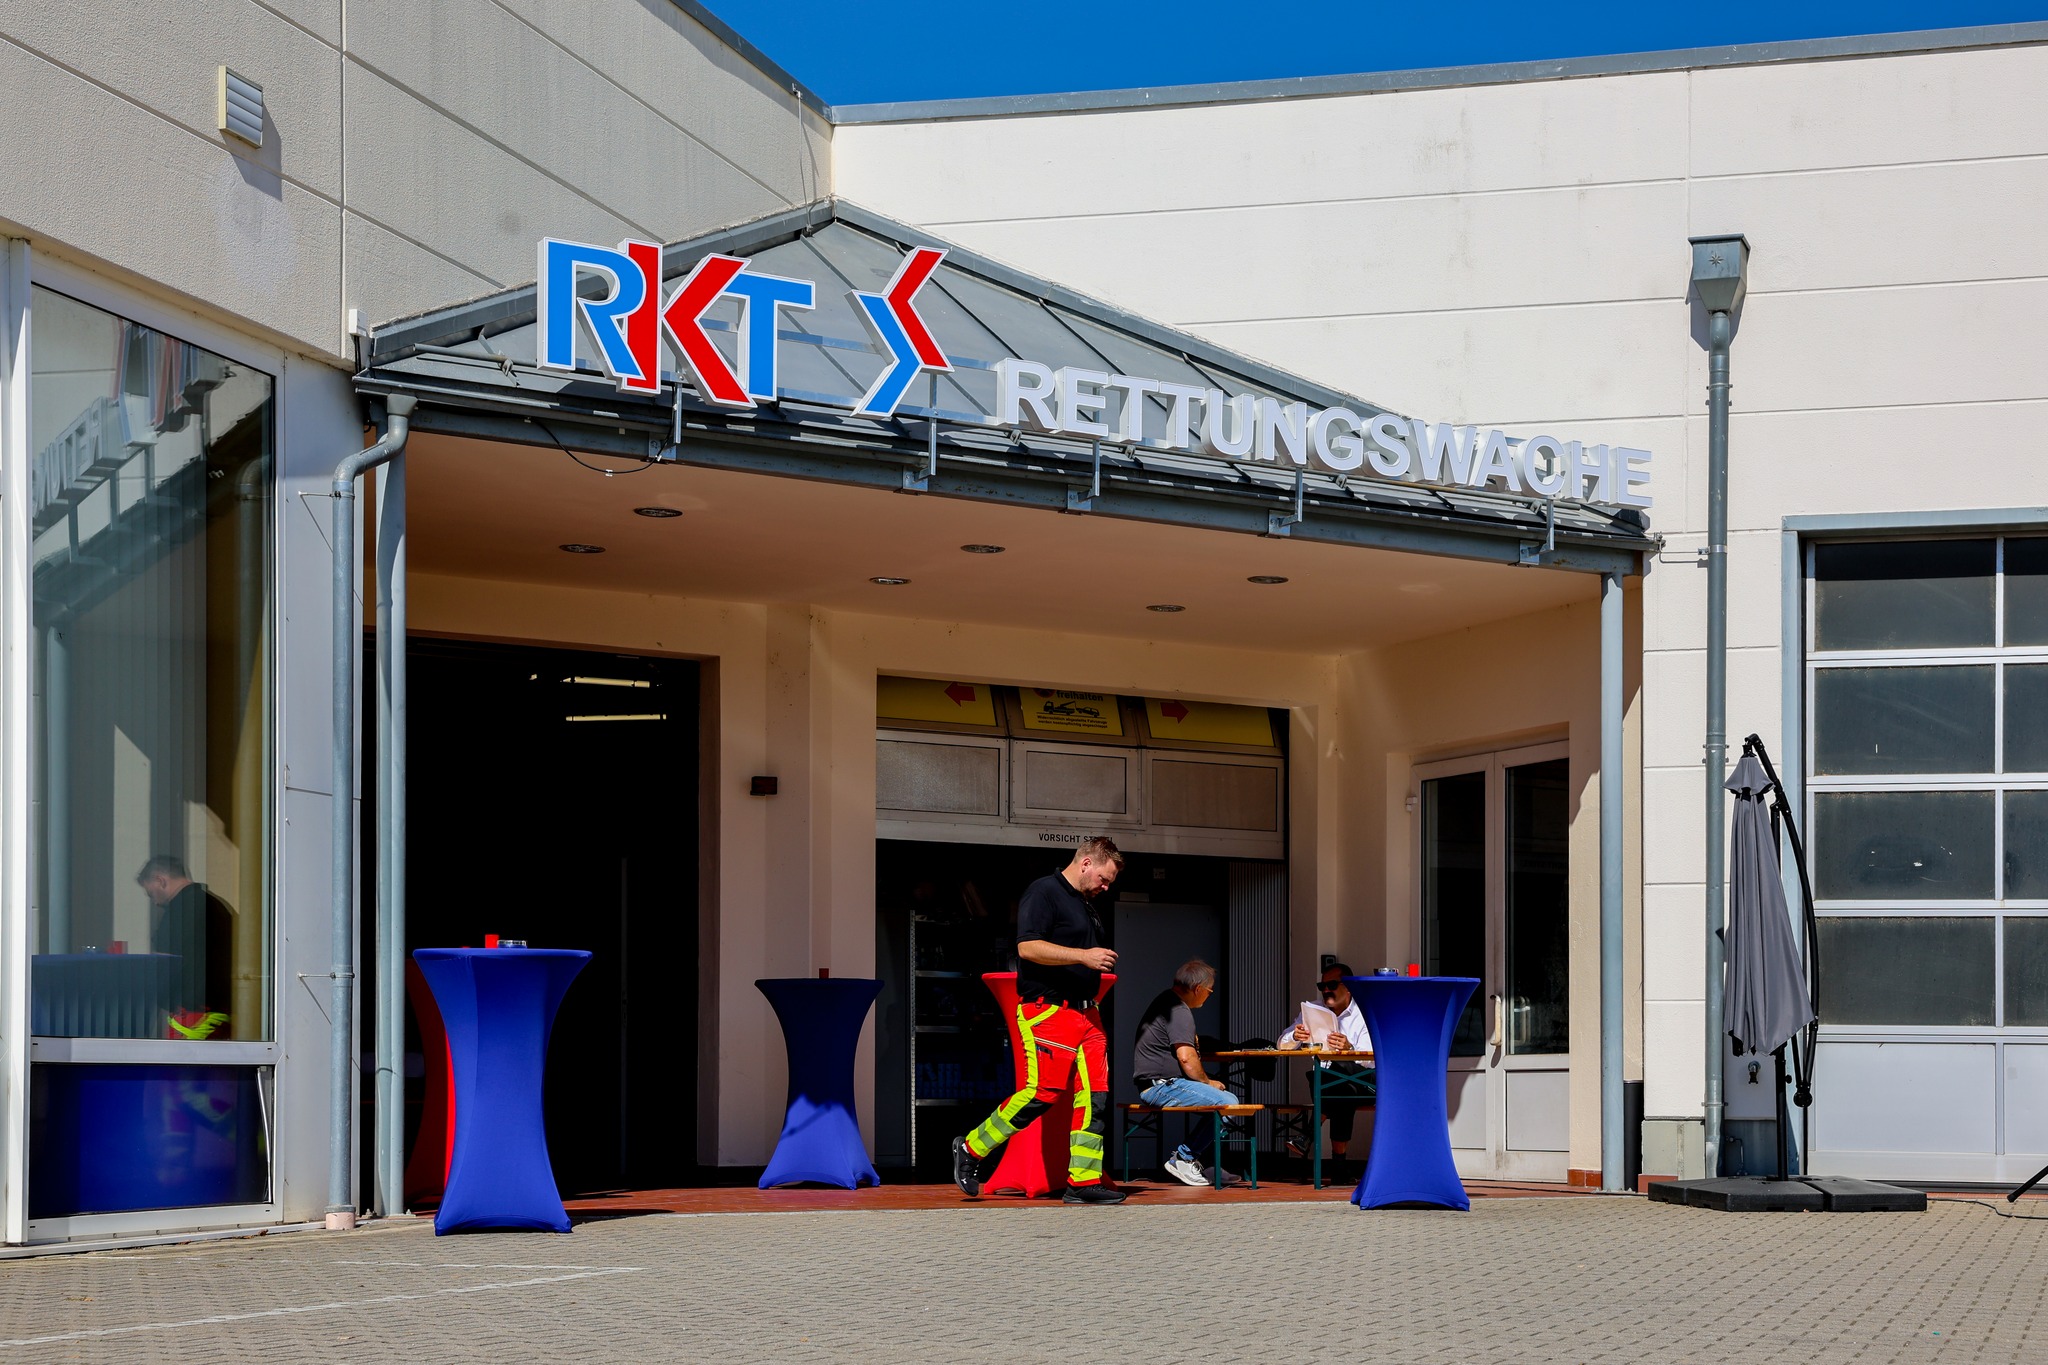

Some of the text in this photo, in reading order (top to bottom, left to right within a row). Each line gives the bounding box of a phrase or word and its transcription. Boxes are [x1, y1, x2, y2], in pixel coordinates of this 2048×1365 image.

[537, 237, 816, 410] RKT
[996, 357, 1653, 510] RETTUNGSWACHE
[1056, 690, 1104, 701] freihalten
[1039, 833, 1081, 843] VORSICHT
